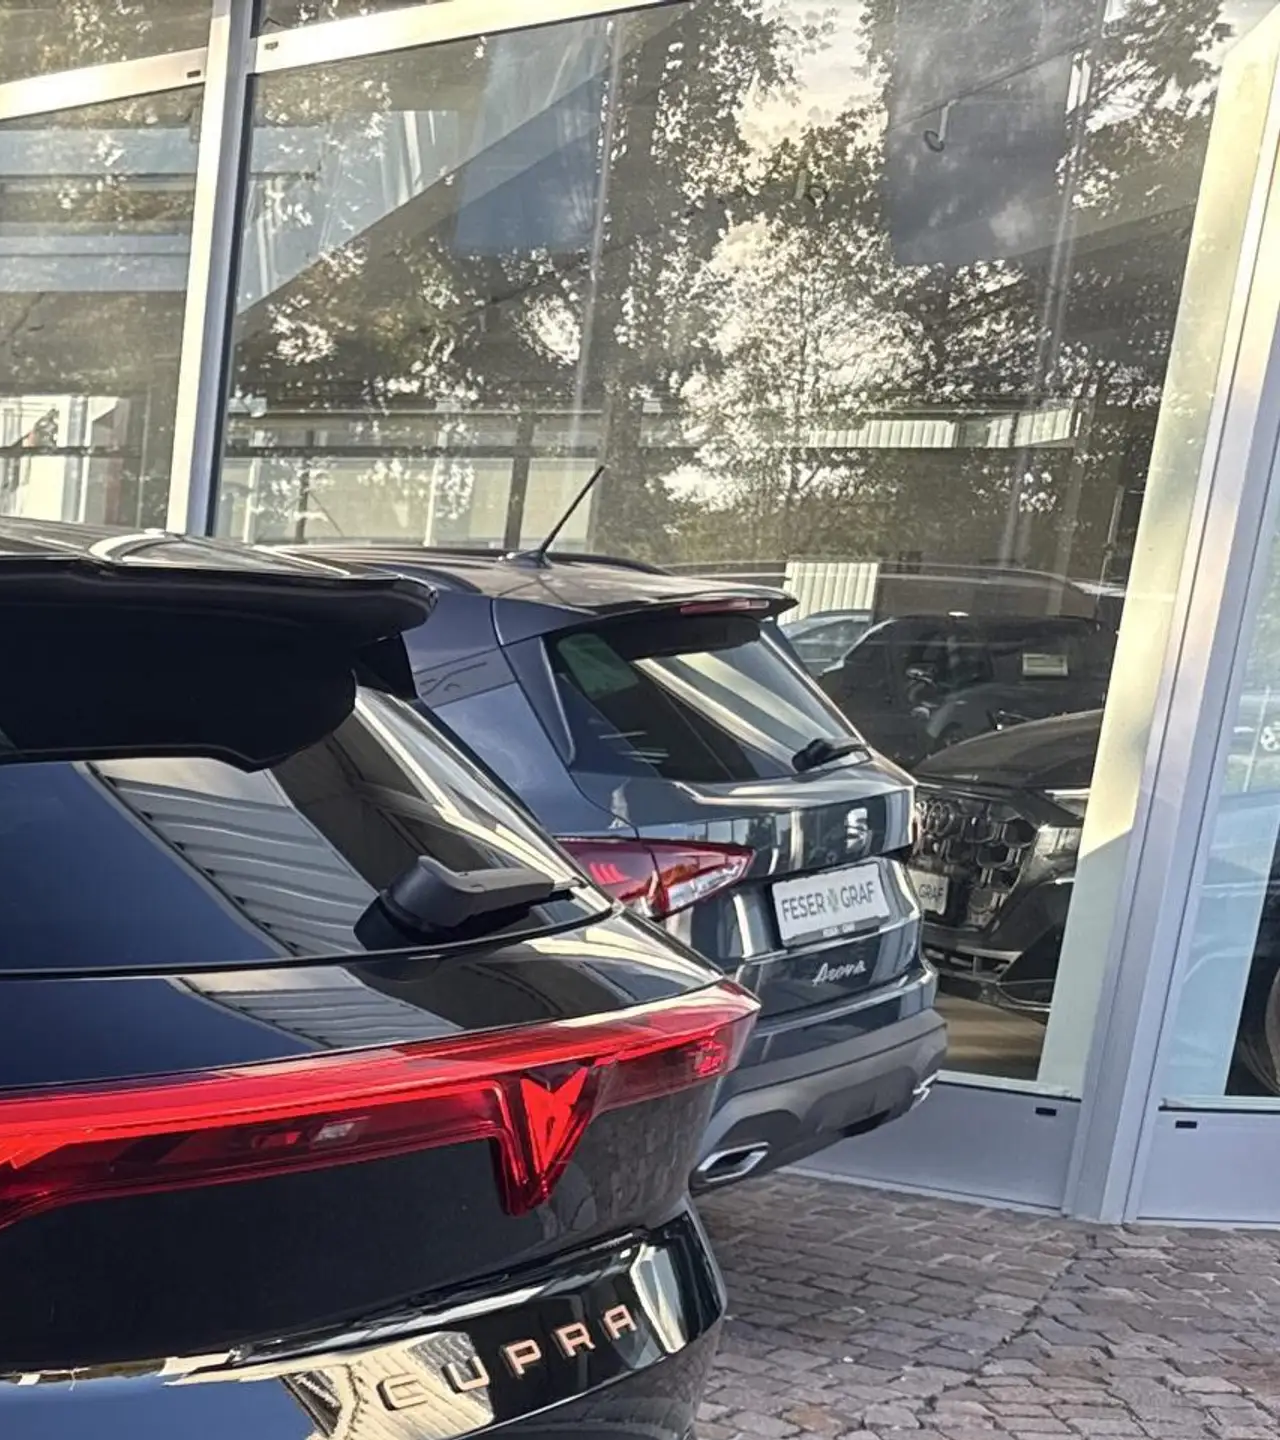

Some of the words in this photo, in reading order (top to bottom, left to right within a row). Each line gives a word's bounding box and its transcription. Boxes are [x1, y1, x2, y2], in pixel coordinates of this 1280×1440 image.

[780, 892, 827, 922] FESER
[840, 880, 875, 909] GRAF
[376, 1303, 638, 1411] CUPRA
